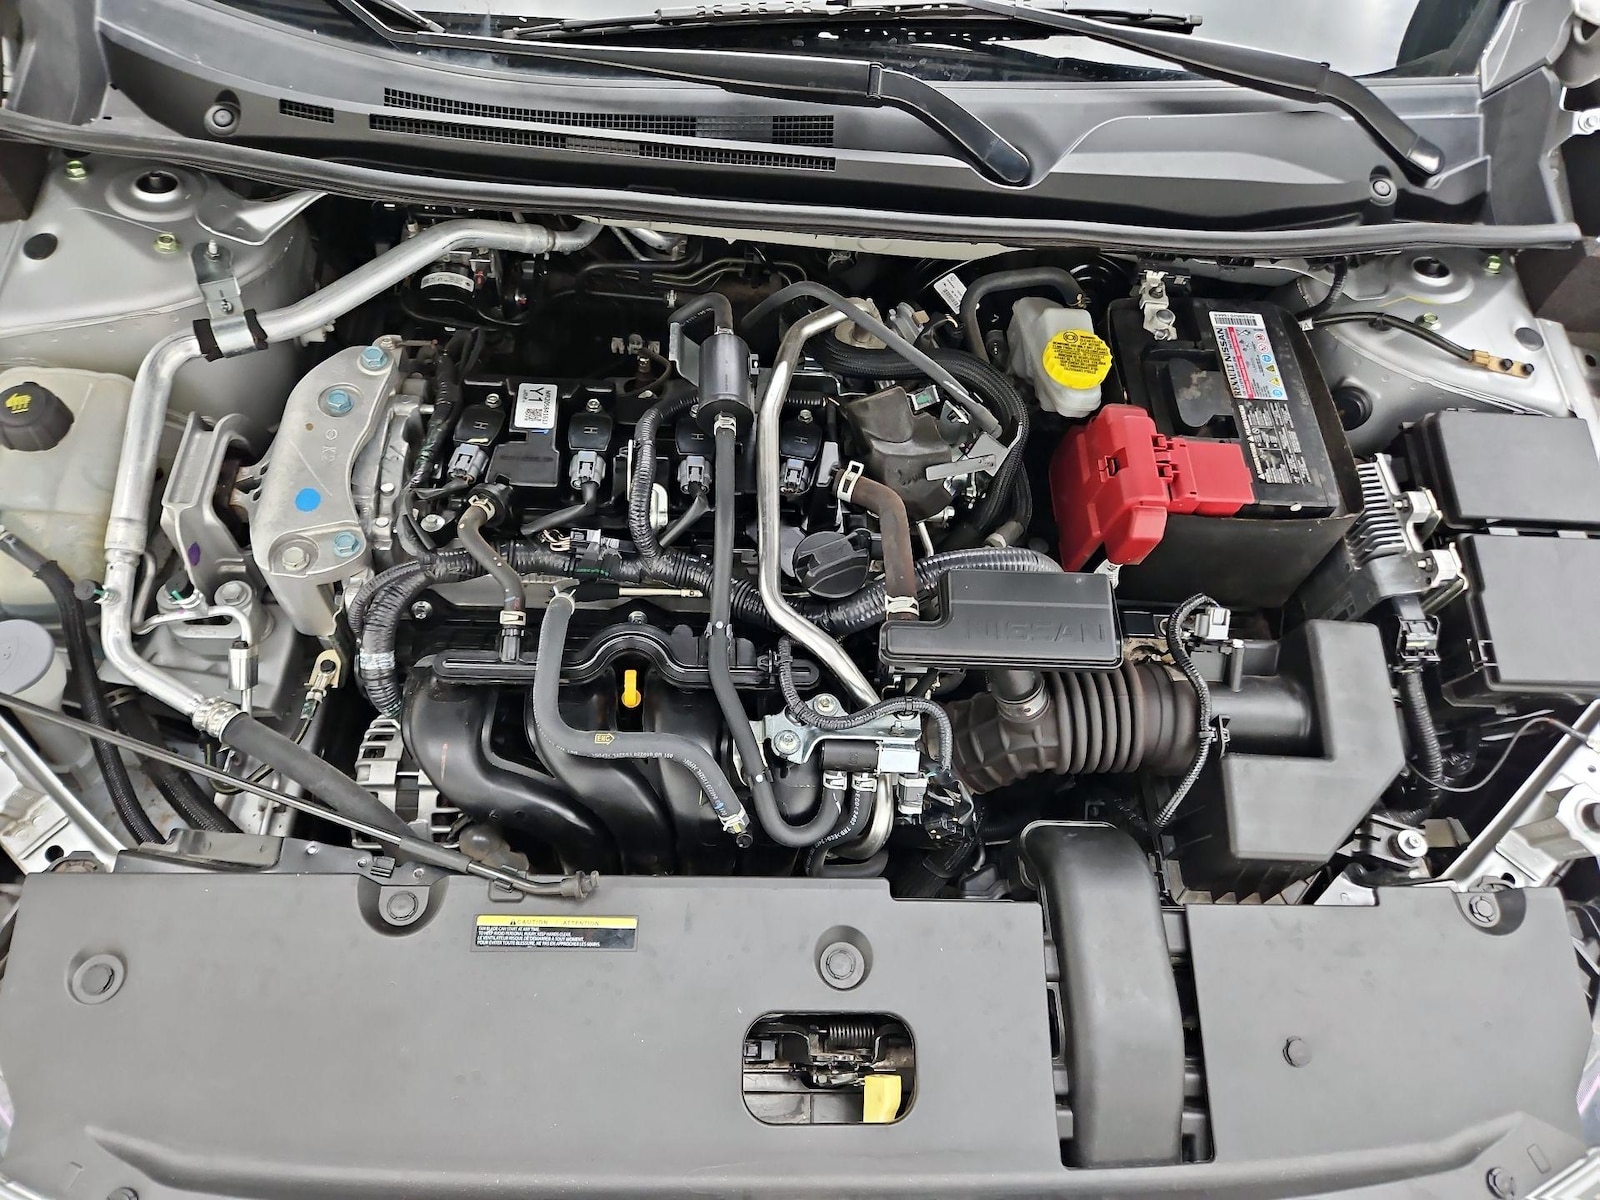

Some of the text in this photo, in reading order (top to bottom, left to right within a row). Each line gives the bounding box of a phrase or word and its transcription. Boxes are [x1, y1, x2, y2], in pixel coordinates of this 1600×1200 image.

[1216, 328, 1242, 396] RENAULT NISSAN
[528, 387, 544, 402] Y1
[967, 621, 1106, 643] NISSAN
